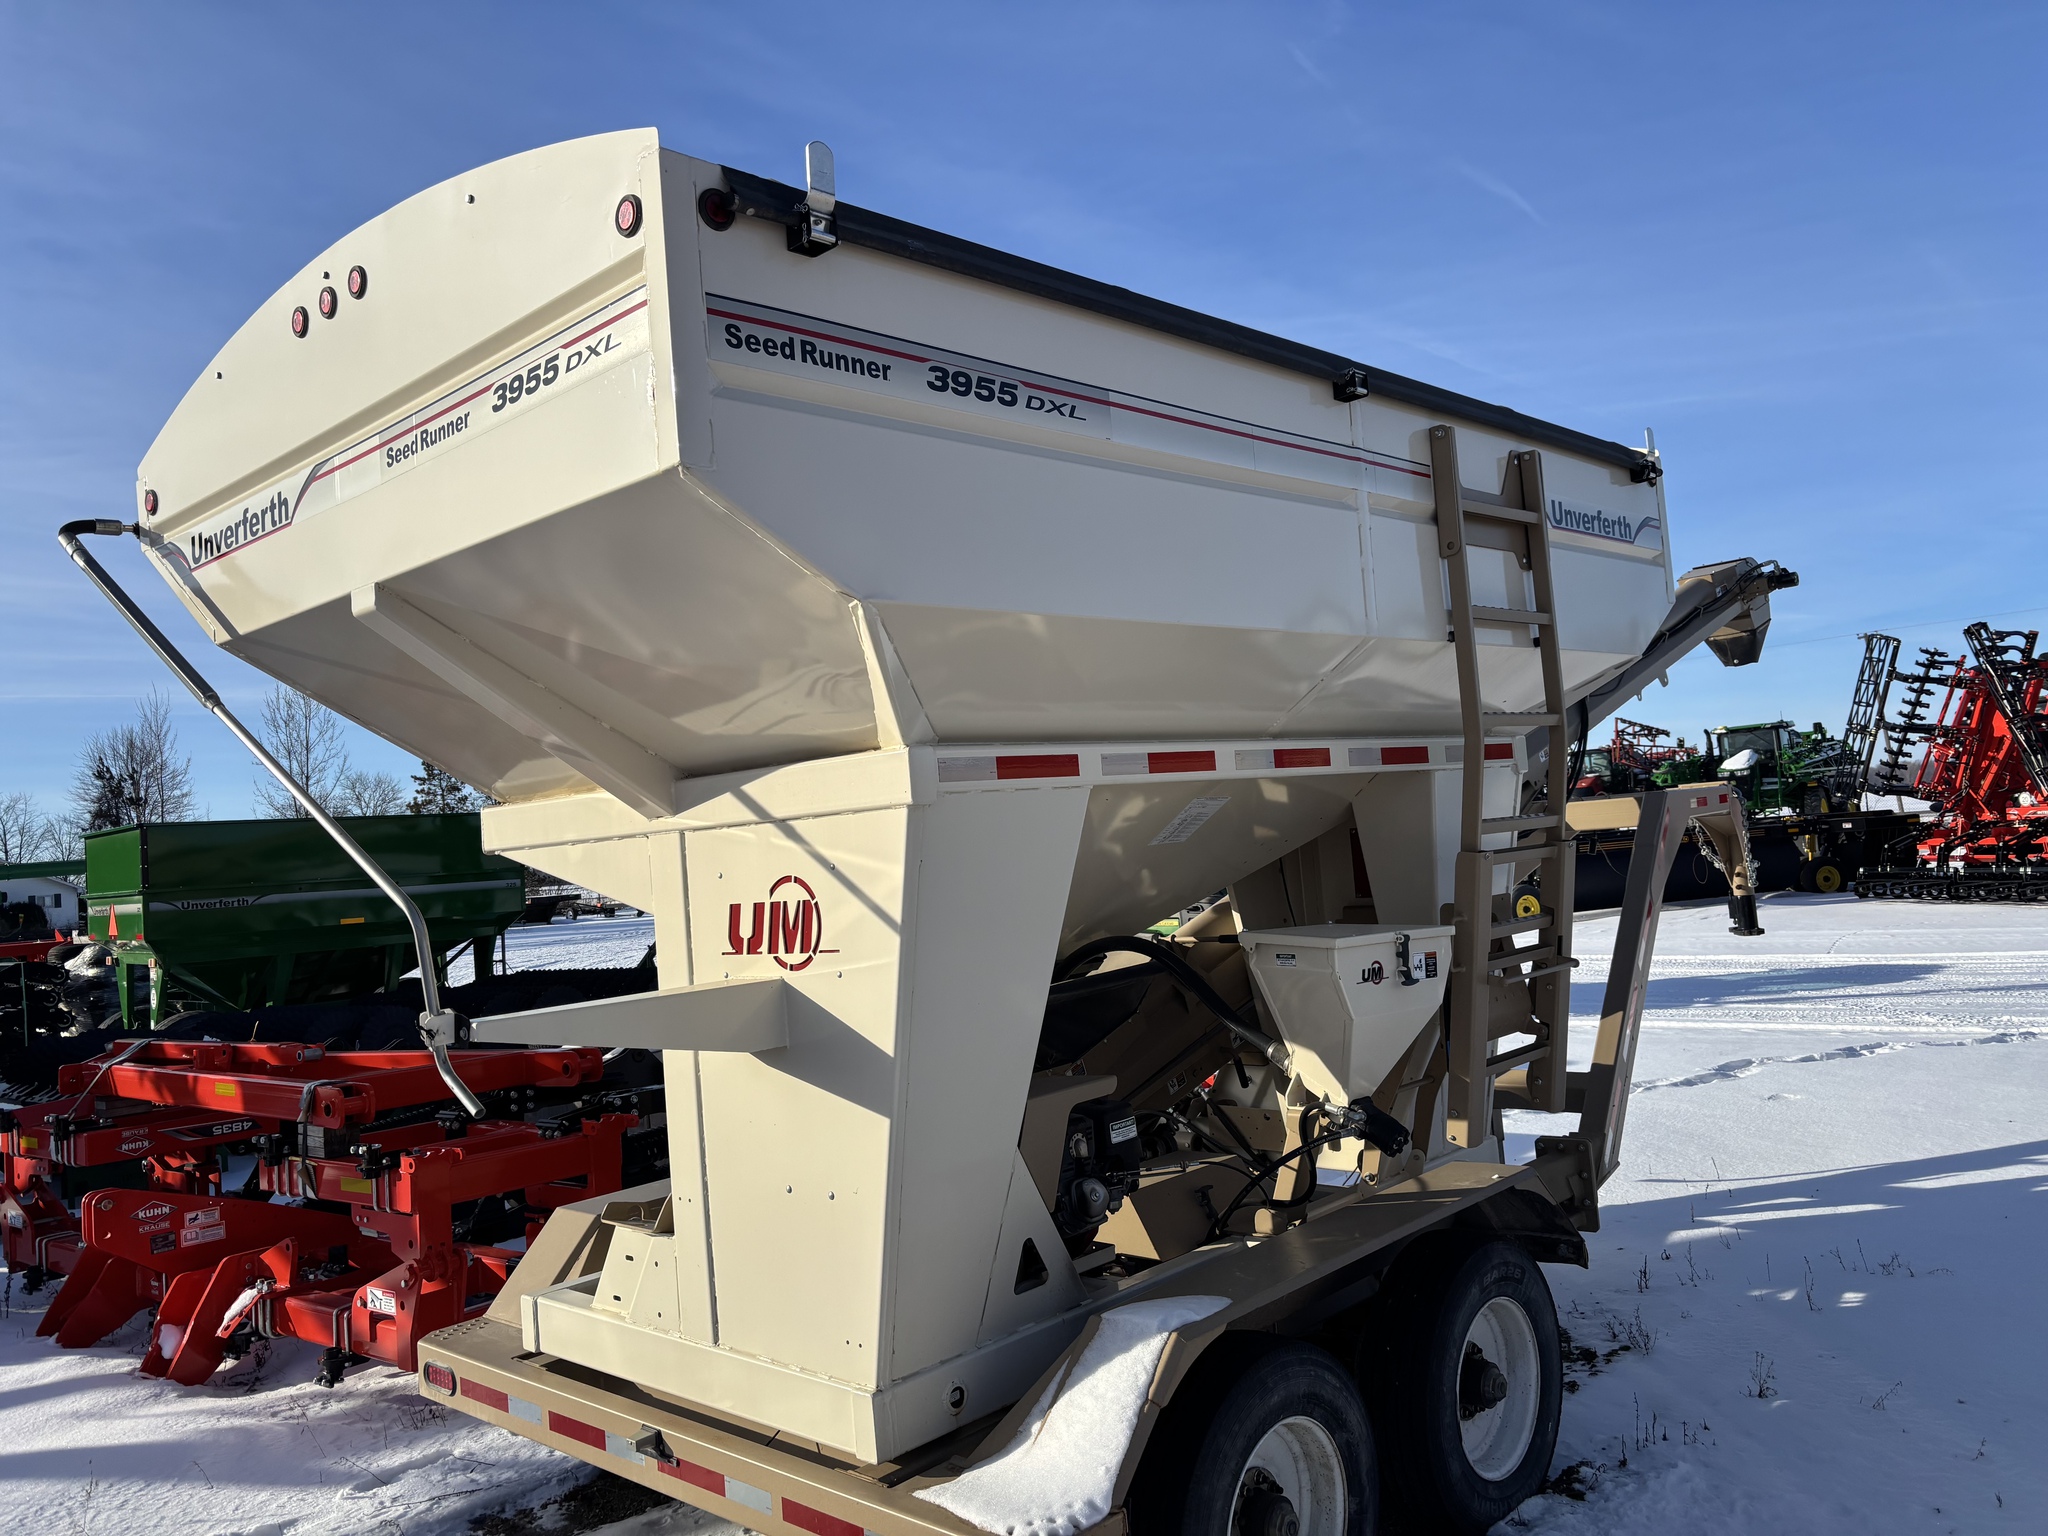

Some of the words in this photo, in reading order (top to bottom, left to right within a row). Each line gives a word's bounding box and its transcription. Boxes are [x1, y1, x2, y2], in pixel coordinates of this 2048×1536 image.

[725, 323, 796, 361] Seed
[799, 339, 892, 382] Runner
[926, 365, 1019, 407] 3955
[1024, 395, 1087, 421] DXL
[386, 433, 419, 468] Seed
[420, 411, 471, 452] Runner
[491, 353, 560, 413] 3955
[565, 333, 622, 374] DXL
[191, 490, 290, 565] Unverferth
[1551, 499, 1633, 540] Unverferth
[181, 898, 250, 910] Unverferth
[726, 897, 816, 956] UM
[1361, 966, 1382, 983] UM
[212, 1121, 253, 1135] 4835
[121, 1140, 149, 1151] KUHN
[138, 1206, 170, 1219] KUHN
[139, 1221, 171, 1234] KRAUSE
